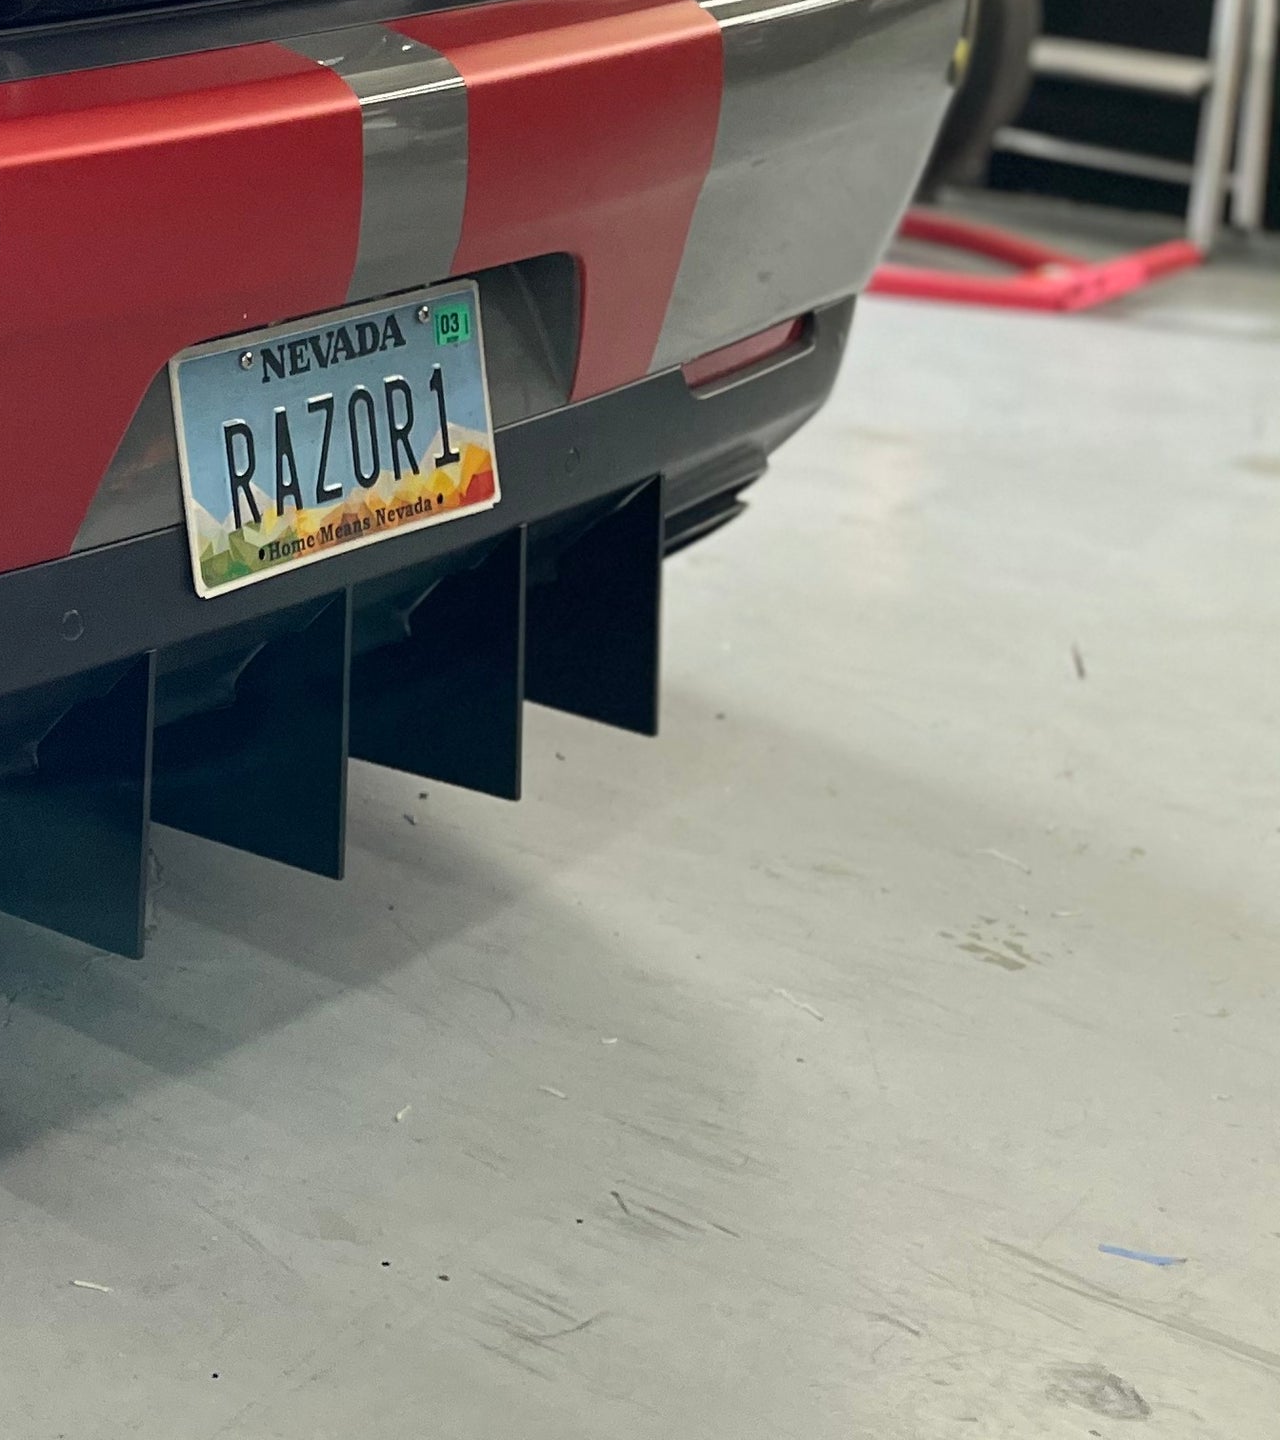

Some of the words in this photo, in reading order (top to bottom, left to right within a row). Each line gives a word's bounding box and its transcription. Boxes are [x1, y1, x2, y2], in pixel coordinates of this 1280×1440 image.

[261, 314, 407, 383] NEVADA
[440, 312, 460, 335] 03
[223, 363, 461, 530] RAZOR1
[269, 533, 315, 561] Home
[319, 517, 371, 544] Means
[375, 495, 433, 526] Nevada
